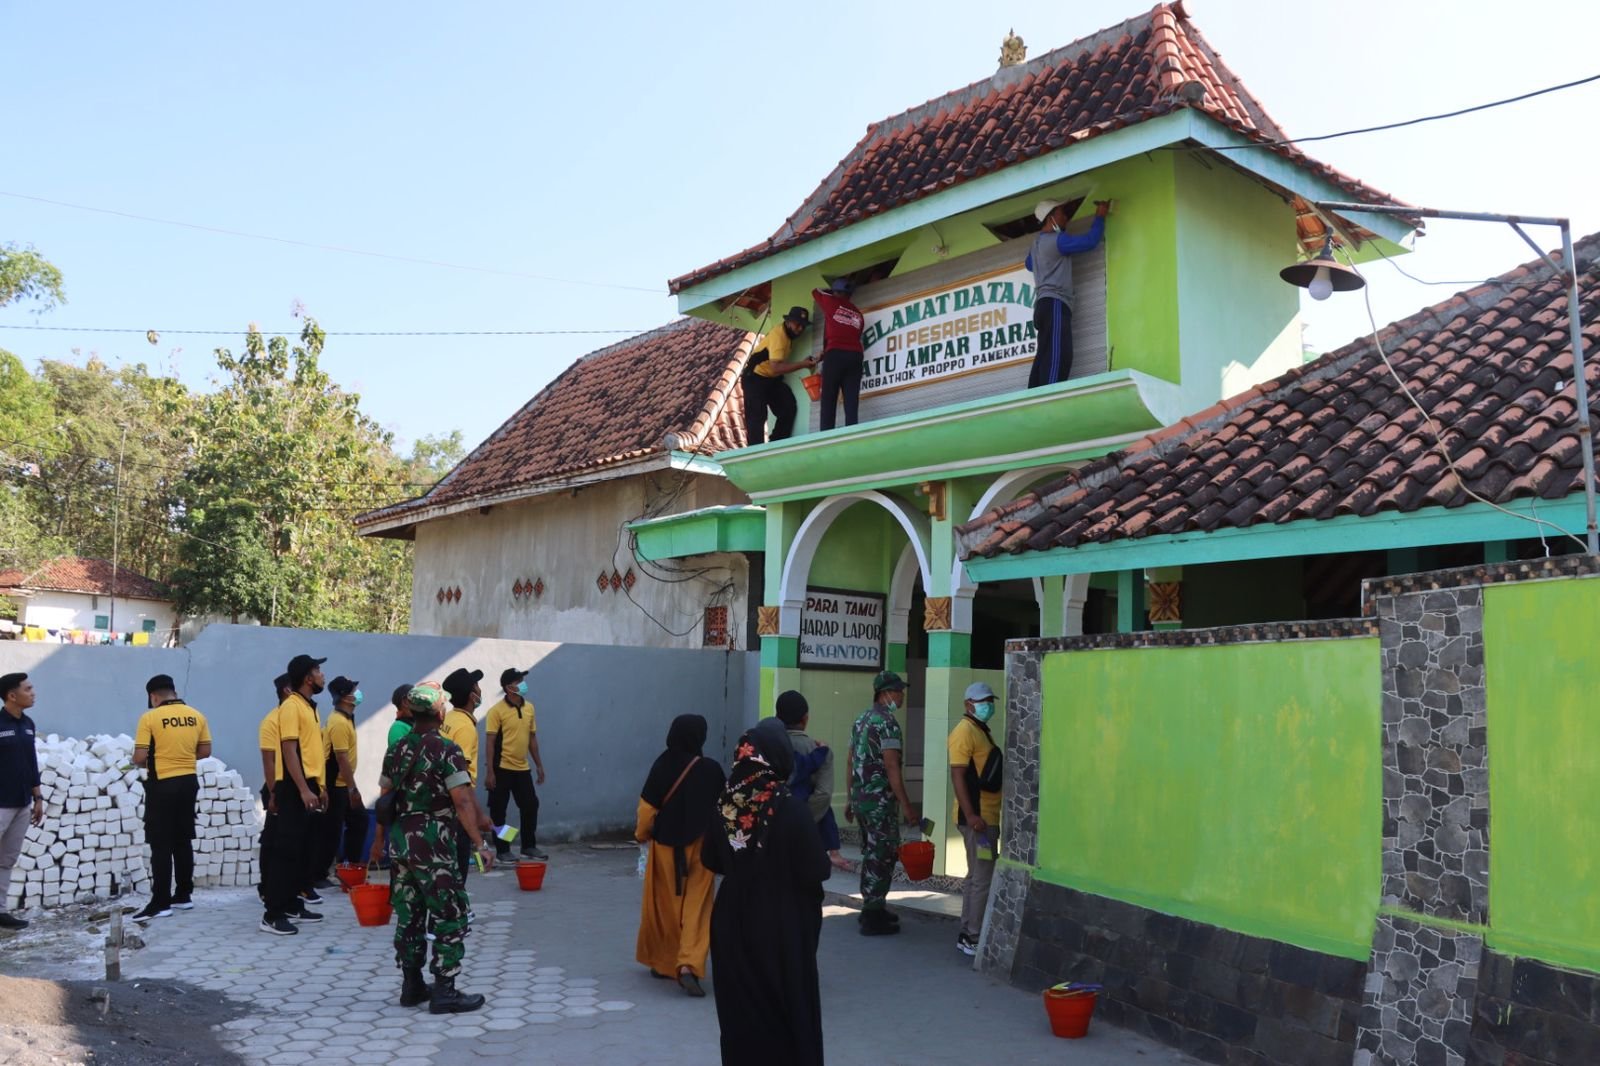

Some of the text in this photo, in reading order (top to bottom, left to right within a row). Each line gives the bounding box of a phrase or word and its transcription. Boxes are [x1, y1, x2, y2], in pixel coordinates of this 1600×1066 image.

[863, 293, 950, 349] ELAMAT
[953, 281, 1036, 310] DATAN
[887, 307, 1008, 353] DI PESAREAN
[861, 320, 1036, 378] ATU AMPAR BARA
[860, 342, 1036, 390] NGBATHOK PROPPO PAMEKKAS
[806, 597, 877, 617] PARA TAMU
[801, 619, 881, 640] HARAP LAPOR
[816, 643, 879, 661] KANTOR
[162, 716, 197, 729] POLISI
